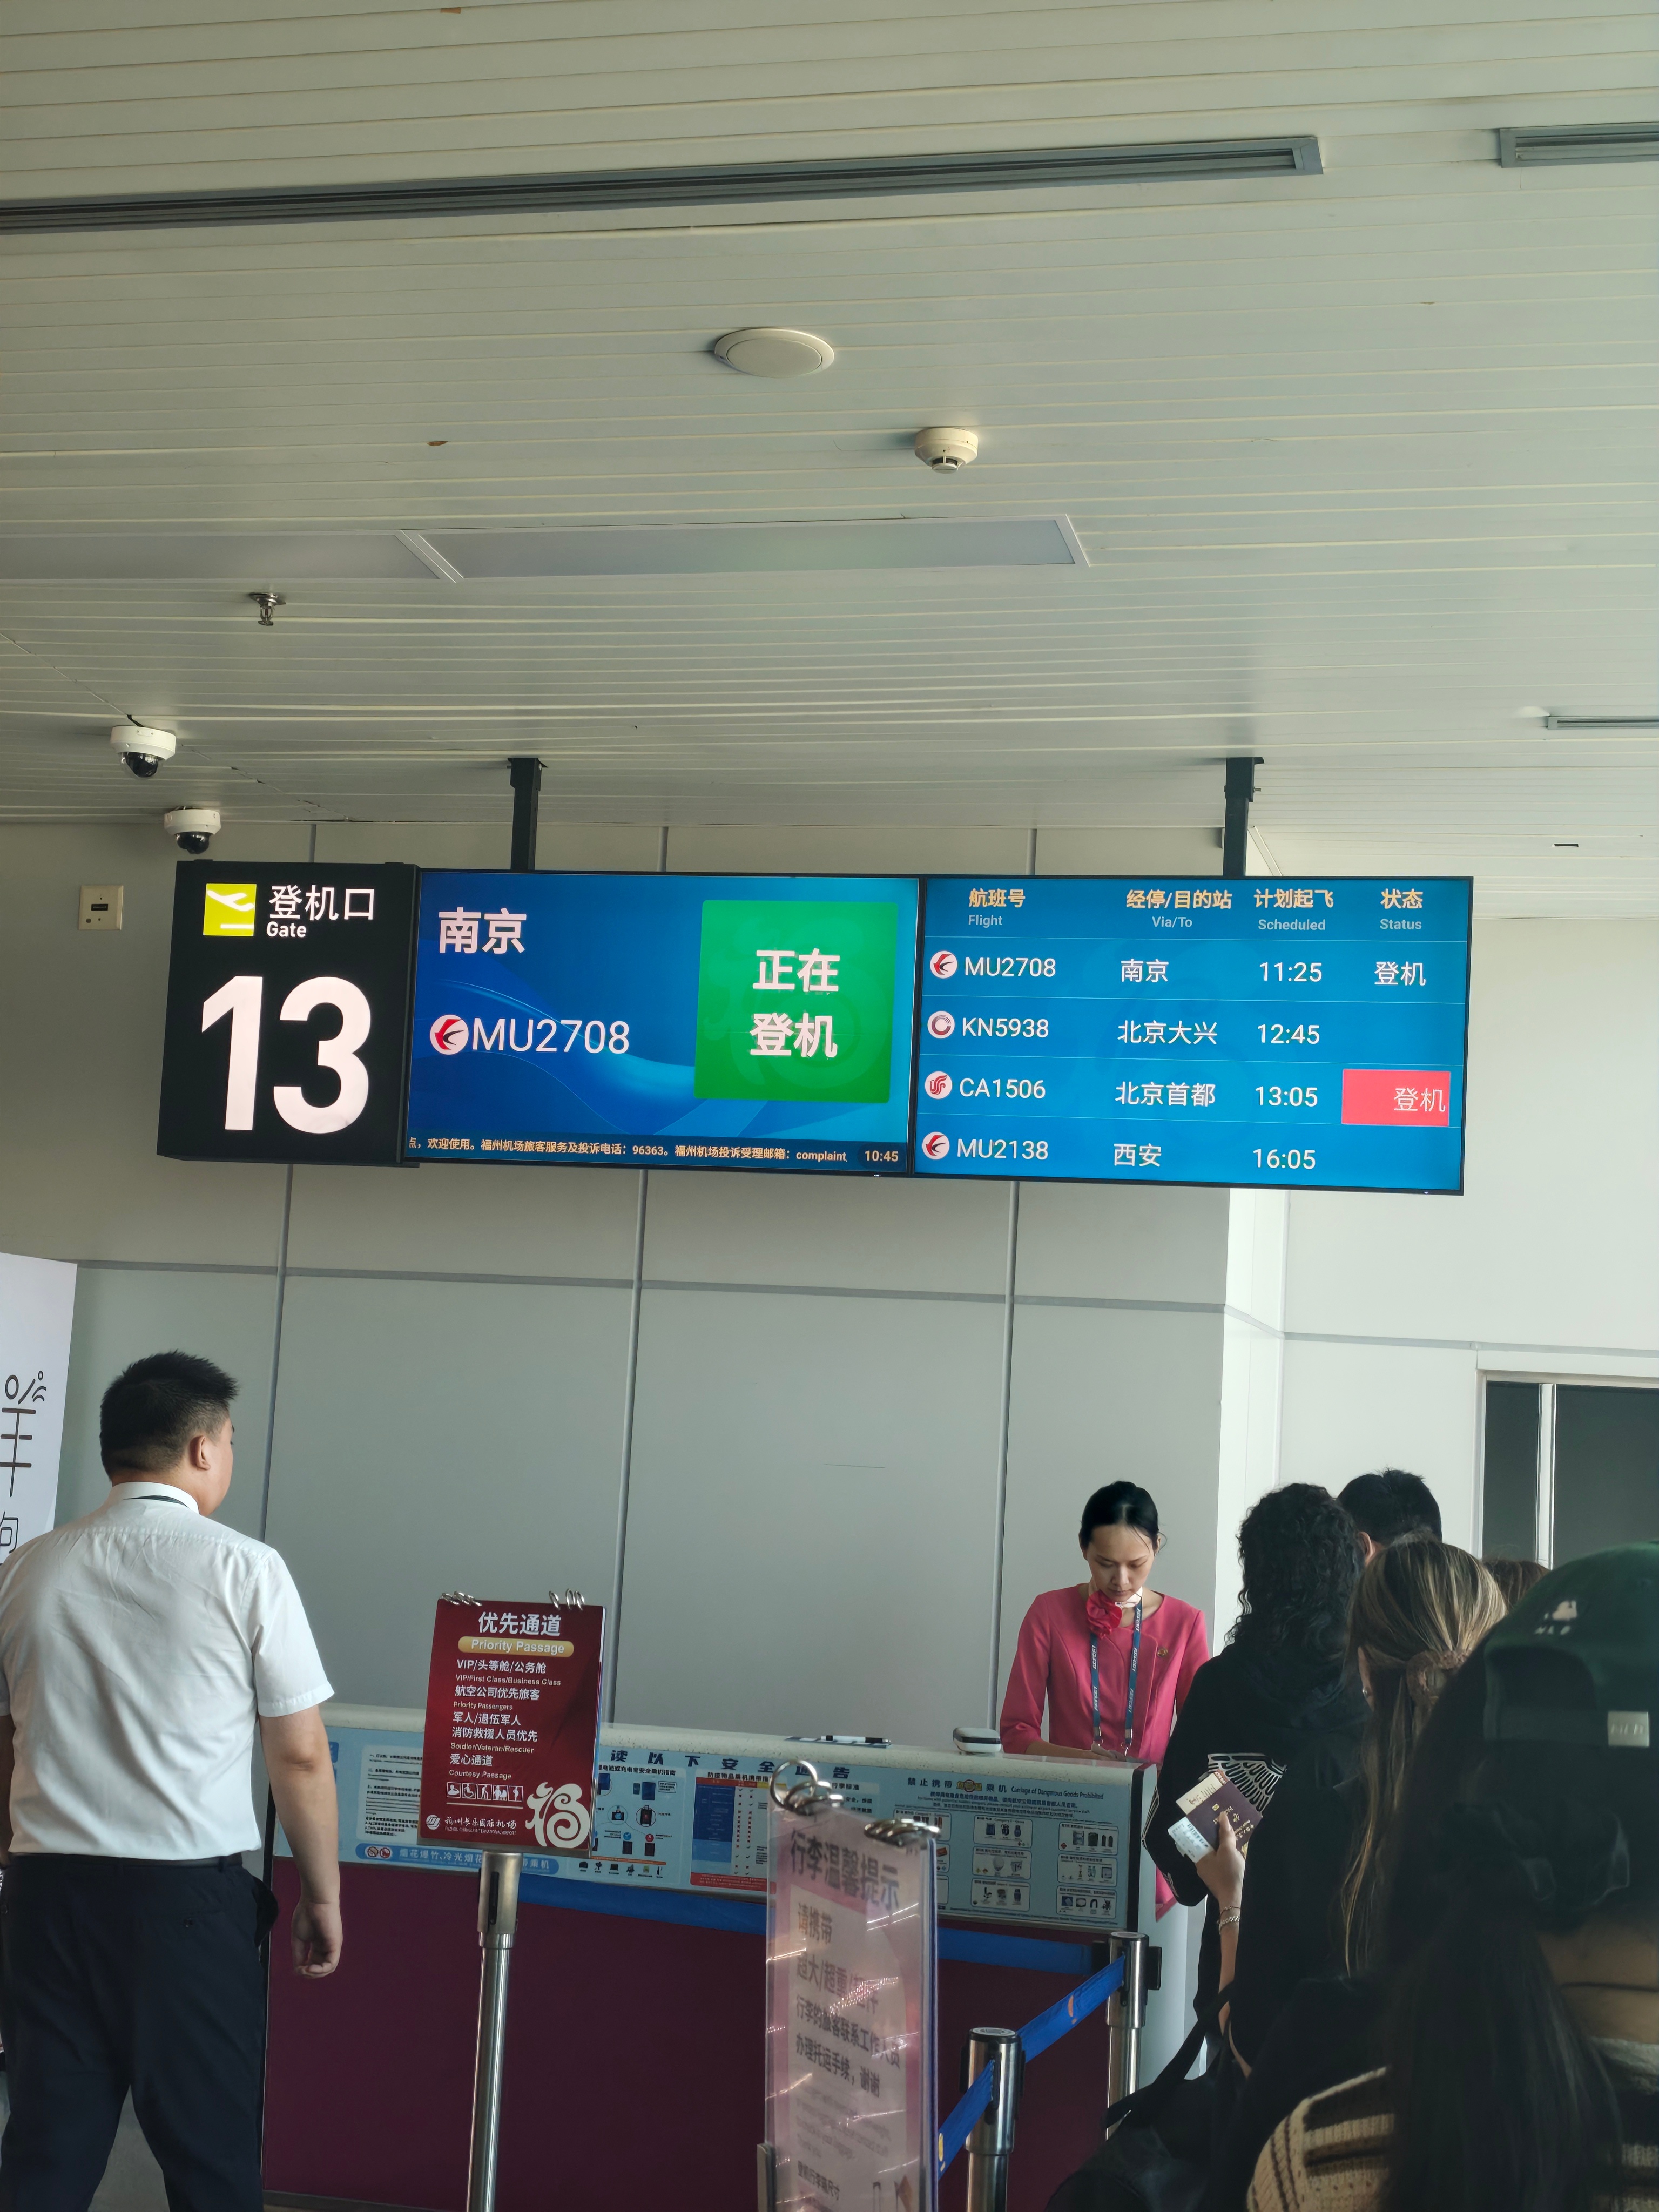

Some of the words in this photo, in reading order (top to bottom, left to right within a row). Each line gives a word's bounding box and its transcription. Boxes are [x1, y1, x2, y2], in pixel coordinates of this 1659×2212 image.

[268, 885, 375, 921] 登机口
[969, 888, 1025, 908] 航班号
[1126, 889, 1232, 910] 经停/目的站
[1253, 889, 1334, 909] 计划起飞
[1381, 889, 1424, 909] 状态
[267, 922, 307, 938] Gate
[439, 907, 527, 954] 南京
[968, 915, 1002, 928] Flight
[1152, 916, 1192, 928] Via/To
[1258, 919, 1326, 930] Scheduled
[1380, 919, 1422, 930] Status
[753, 948, 840, 992] 正在
[965, 957, 1056, 977] MU2708
[1121, 959, 1169, 982] 南京
[1259, 962, 1323, 982] 11:25
[1374, 961, 1426, 986] 登机
[473, 1018, 629, 1054] MU2708
[750, 1013, 838, 1058] 登机
[962, 1017, 1049, 1038] KN5938
[1117, 1020, 1218, 1045] 北京大兴
[1257, 1024, 1320, 1044] 12:45
[201, 976, 371, 1134] 13
[960, 1078, 1046, 1099] CA1506
[1115, 1082, 1216, 1107] 北京首都
[1256, 1086, 1318, 1107] 13:05
[1394, 1088, 1446, 1112] 登机
[865, 1150, 899, 1163] 10:45
[957, 1138, 1048, 1160] MU2138
[1114, 1143, 1162, 1168] 西安
[1253, 1149, 1316, 1169] 16:05
[478, 1611, 562, 1636] 优先通道
[471, 1639, 512, 1654] Priority
[516, 1642, 564, 1656] Passage
[457, 1659, 547, 1674] VIP/头等舱/公务舱
[456, 1674, 484, 1682] VIP/First
[487, 1676, 539, 1685] Class/Business
[455, 1685, 540, 1701] 航空公司优先旅客
[454, 1701, 476, 1709] Priority
[478, 1702, 512, 1711] Passengers
[453, 1711, 521, 1726] 军人/退伍军人
[451, 1726, 538, 1742] 消防救援人员优先
[450, 1743, 534, 1754] Soldier/Veteran/Rescuer
[450, 1753, 493, 1766] 爱心通道
[449, 1770, 480, 1779] Courtesy
[482, 1771, 512, 1781] Passage
[790, 1829, 900, 1910] 行李温馨提示
